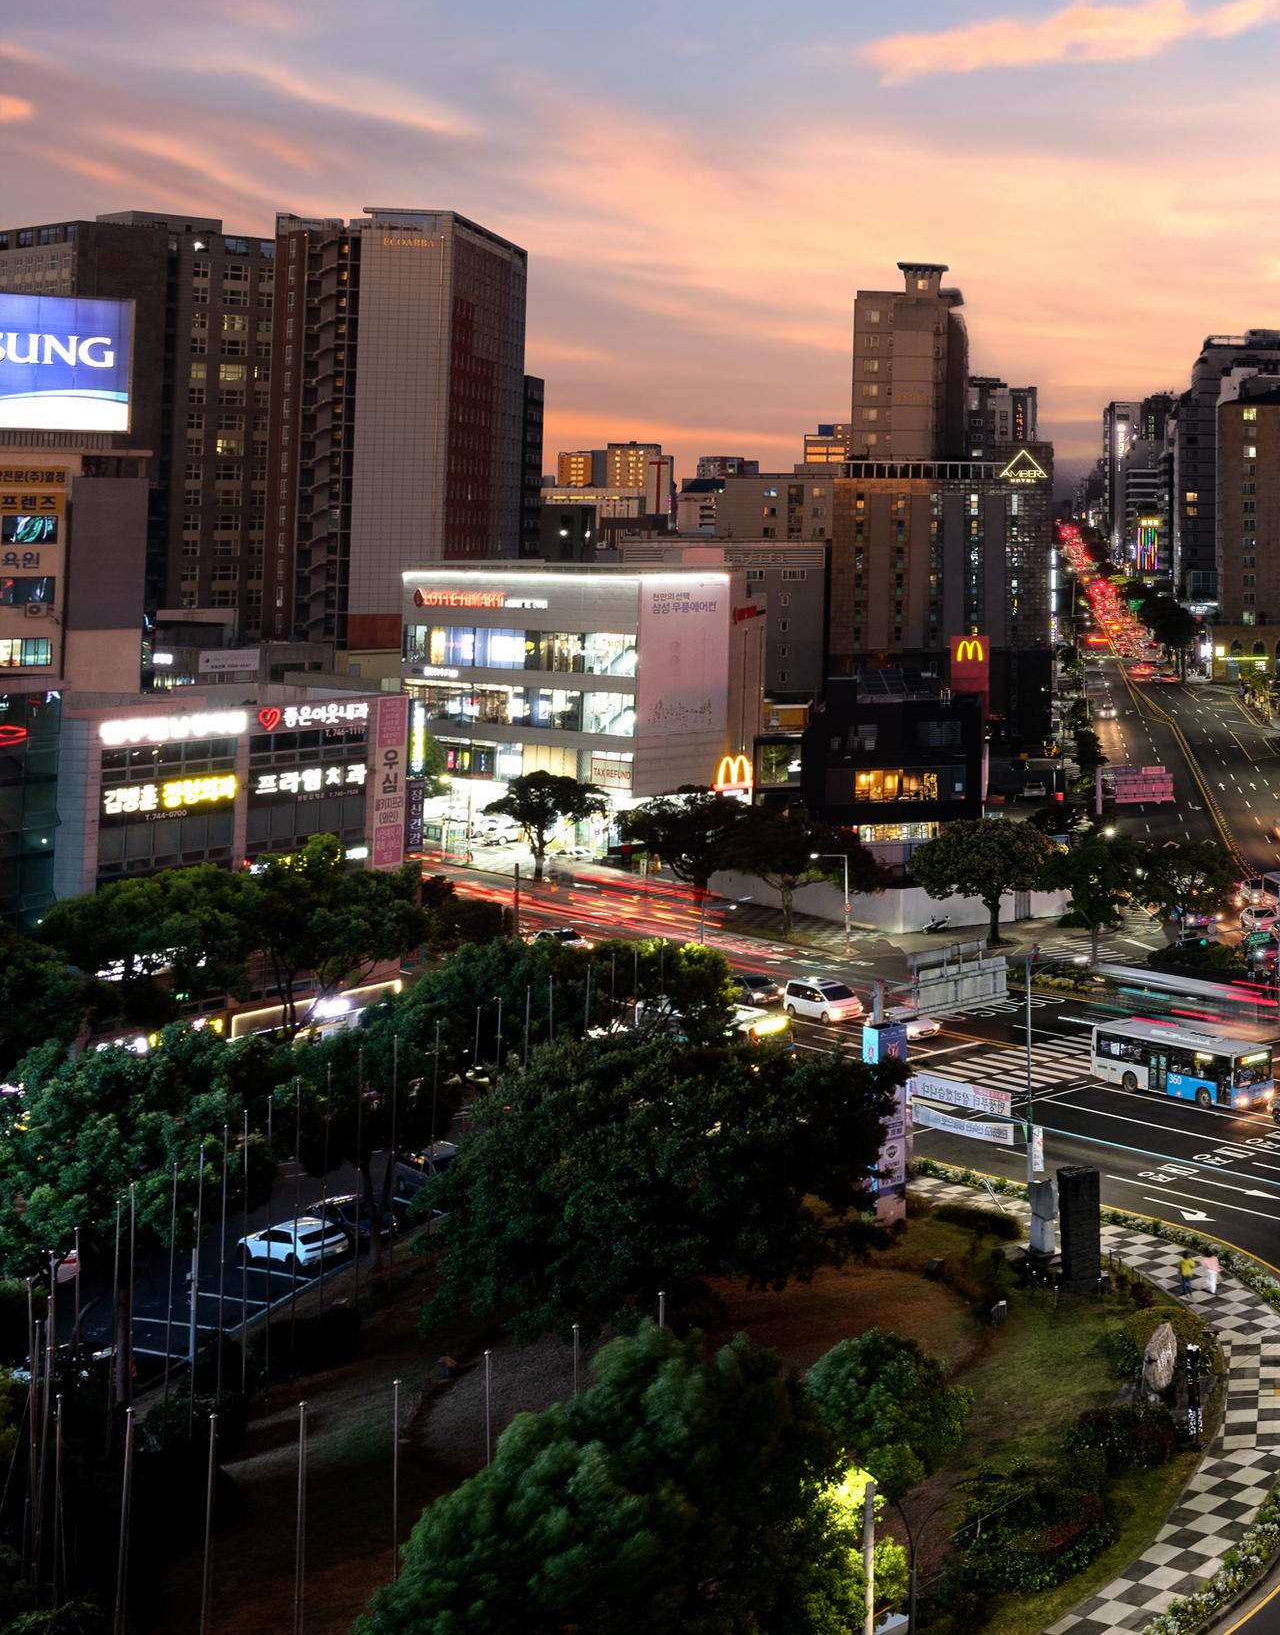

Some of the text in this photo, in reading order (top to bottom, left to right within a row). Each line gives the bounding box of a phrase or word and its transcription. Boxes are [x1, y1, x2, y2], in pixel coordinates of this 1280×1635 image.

[1000, 469, 1048, 478] AMBER
[422, 590, 459, 606] LOTTE
[460, 591, 505, 608] HIMART
[652, 602, 671, 614] 삼성
[283, 703, 369, 728] 좋은이웃내과
[255, 763, 367, 794] 프라임 치과
[593, 767, 632, 780] TAX REFUND
[409, 789, 423, 844] 정신건강
[1169, 1073, 1182, 1086] 360
